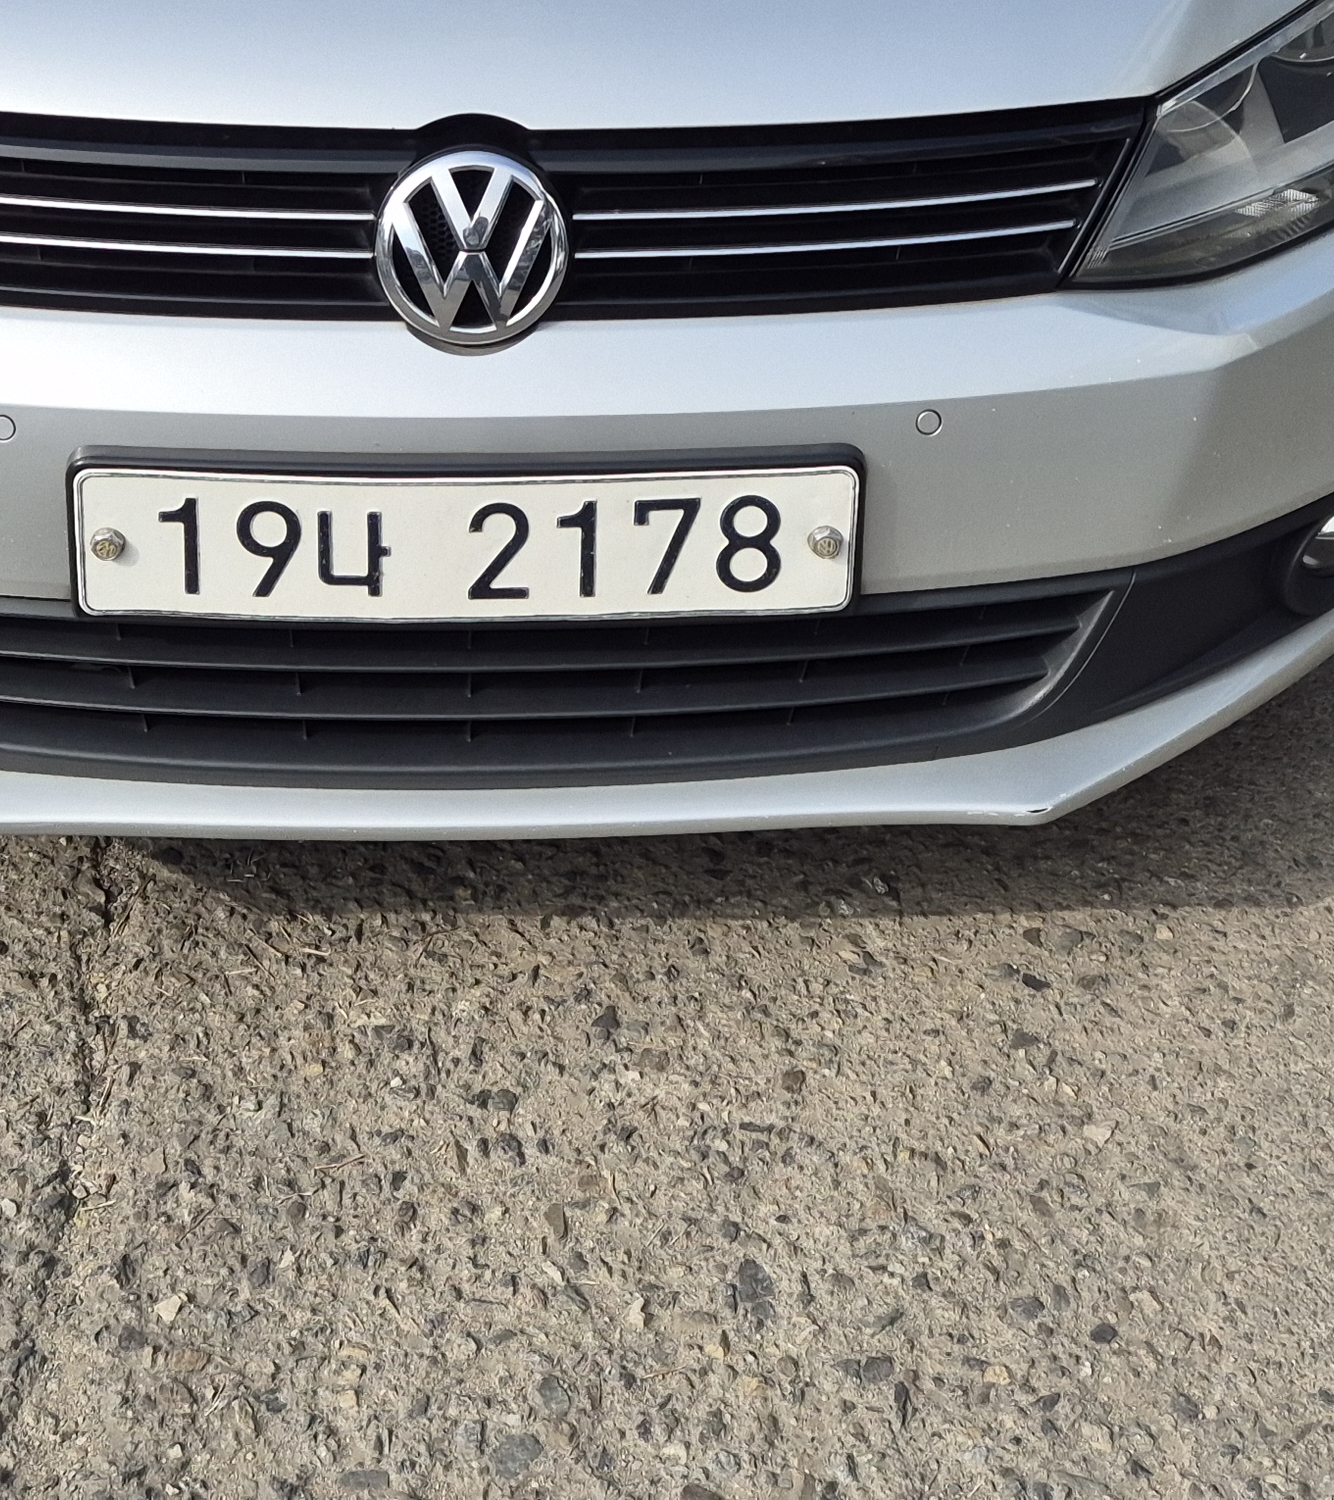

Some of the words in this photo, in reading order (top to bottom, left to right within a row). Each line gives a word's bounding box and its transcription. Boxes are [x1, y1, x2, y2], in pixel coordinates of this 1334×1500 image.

[376, 150, 569, 344] VW
[157, 497, 392, 597] 19나
[467, 494, 782, 600] 2178
